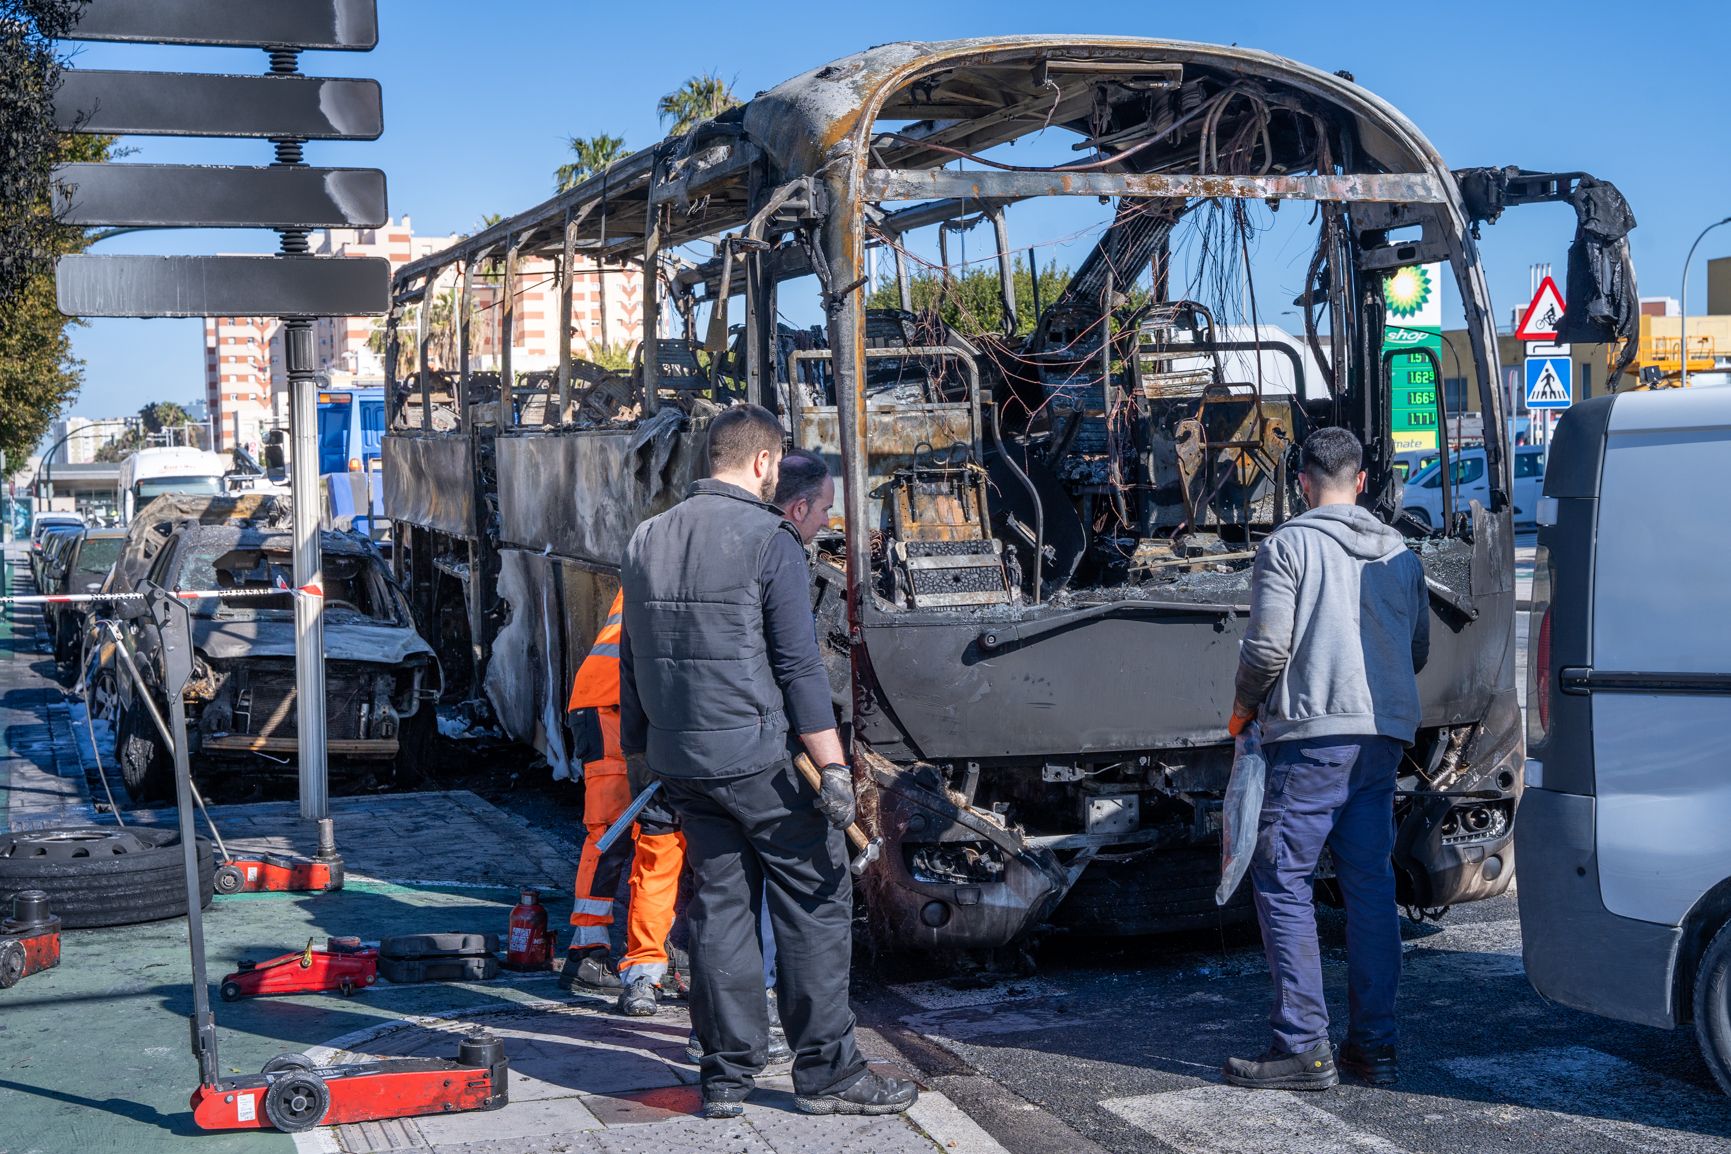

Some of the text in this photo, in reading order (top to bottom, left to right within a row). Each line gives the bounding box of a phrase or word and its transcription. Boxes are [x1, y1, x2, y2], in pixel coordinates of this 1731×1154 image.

[1387, 329, 1430, 343] shop
[1410, 371, 1435, 384] 1.629
[1410, 392, 1435, 405] 1.669
[1411, 412, 1435, 425] 1.771
